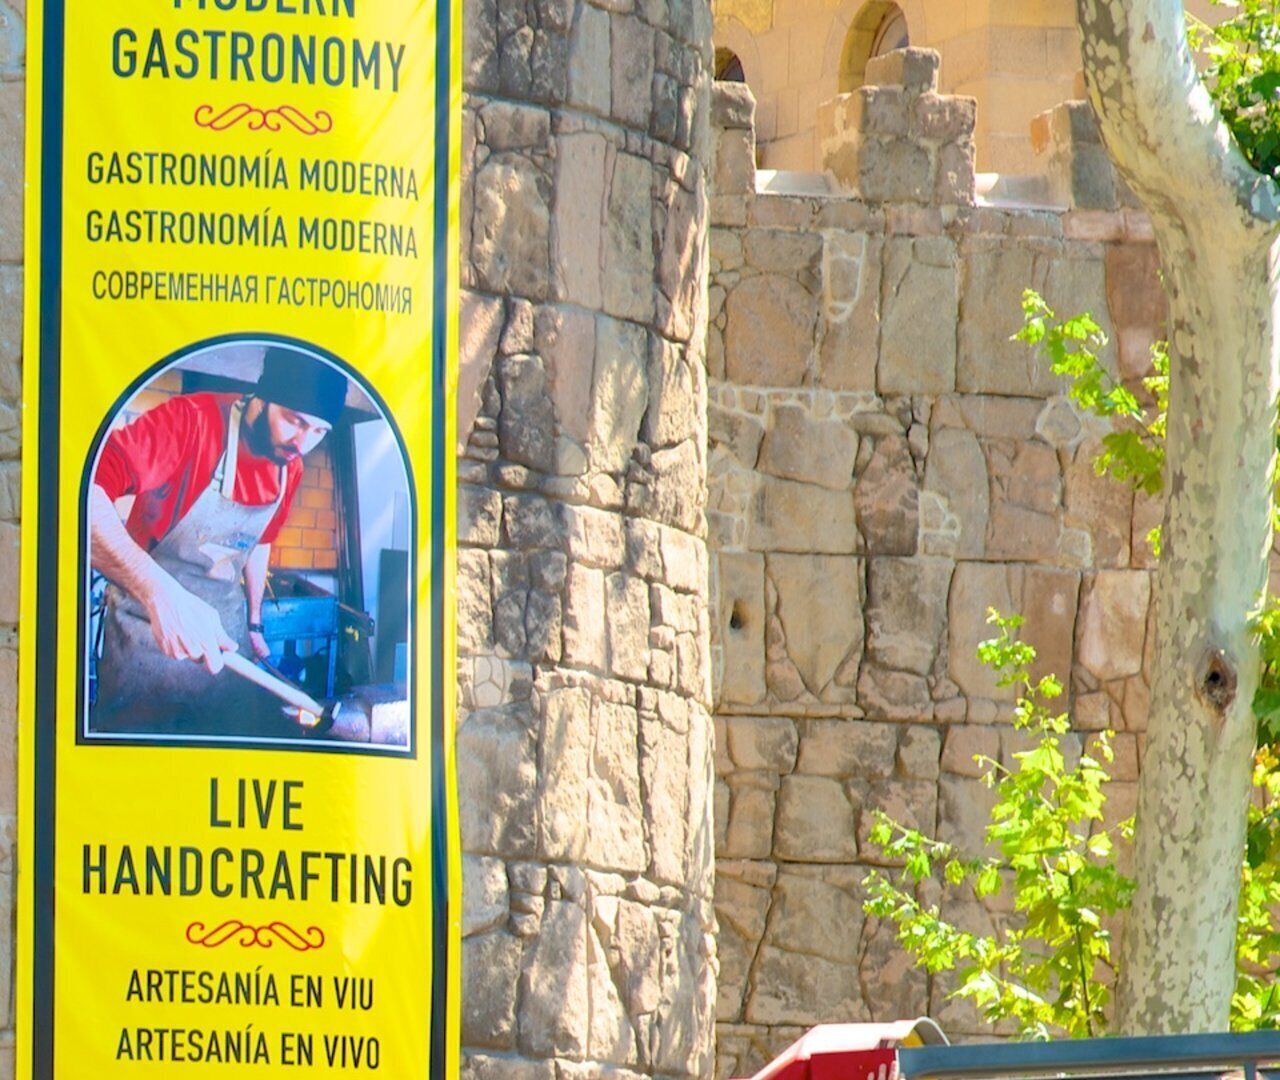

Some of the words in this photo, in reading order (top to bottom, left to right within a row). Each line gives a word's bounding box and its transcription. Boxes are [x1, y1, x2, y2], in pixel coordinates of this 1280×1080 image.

[112, 28, 405, 92] GASTRONOMY
[87, 149, 288, 189] GASTRONOMÍA
[300, 159, 418, 200] MODERNA
[86, 207, 287, 248] GASTRONOMÍA
[299, 217, 417, 258] MODERNA
[92, 271, 257, 303] СОВРЕМЕННАЯ
[266, 276, 411, 313] ГАСТРОНОМИЯ
[209, 778, 303, 831] LIVE
[82, 844, 412, 907] HANDCRAFTING
[126, 966, 279, 1007] ARTESANÍA
[291, 975, 322, 1008] EN
[333, 977, 373, 1010] VIU
[116, 1024, 270, 1065] ARTESANÍA
[281, 1033, 312, 1066] EN
[324, 1035, 380, 1069] VIVO
